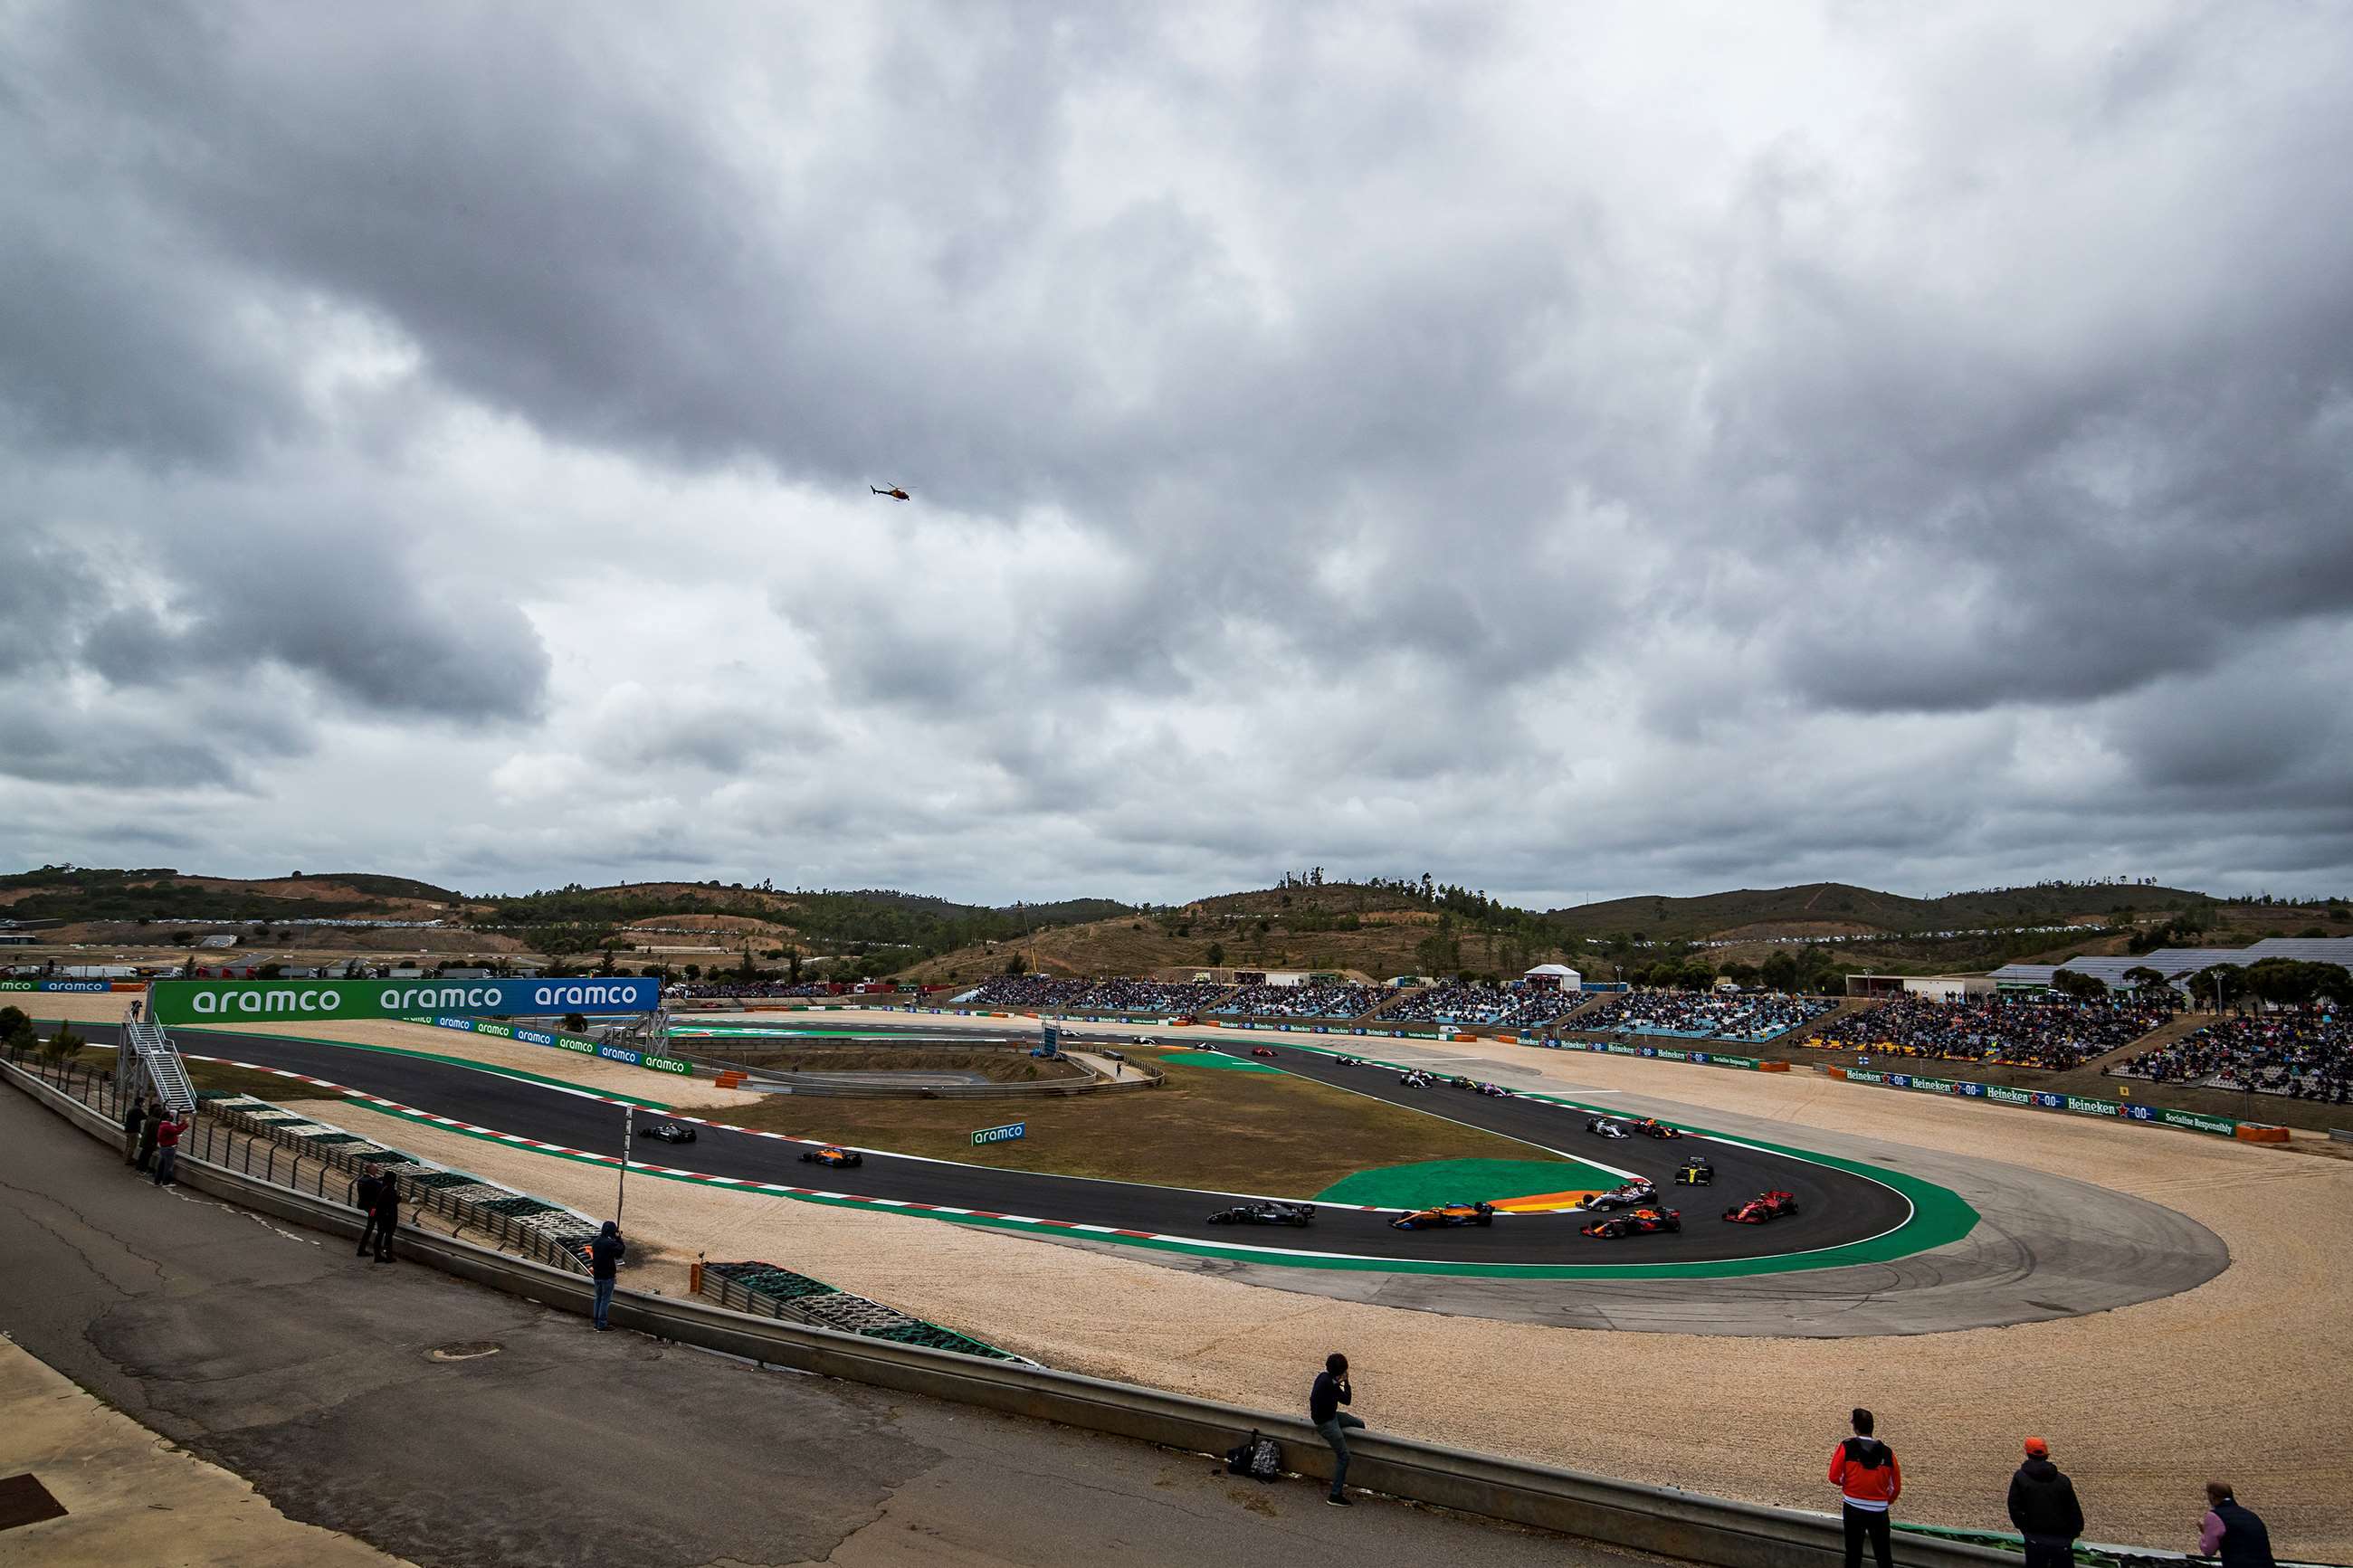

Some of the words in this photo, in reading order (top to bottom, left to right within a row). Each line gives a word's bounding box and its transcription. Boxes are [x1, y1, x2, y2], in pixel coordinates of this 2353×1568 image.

[1, 981, 31, 990] mco
[49, 983, 102, 991] aramco
[193, 990, 340, 1013] aramco
[380, 988, 502, 1010] aramco
[535, 986, 637, 1005] aramco
[440, 1017, 470, 1030] aramco
[478, 1023, 510, 1036] aramco
[519, 1031, 550, 1044] aramco
[559, 1038, 593, 1053] aramco
[602, 1047, 635, 1062] aramco
[646, 1057, 684, 1072] aramco
[1846, 1069, 1881, 1082] Heineken
[1912, 1078, 1950, 1092] Heineken
[1987, 1087, 2028, 1103] Heineken
[2068, 1098, 2115, 1115] Heineken
[2166, 1113, 2194, 1126] Socialise
[2195, 1118, 2232, 1135] Responsibly
[975, 1126, 1022, 1144] aramco
